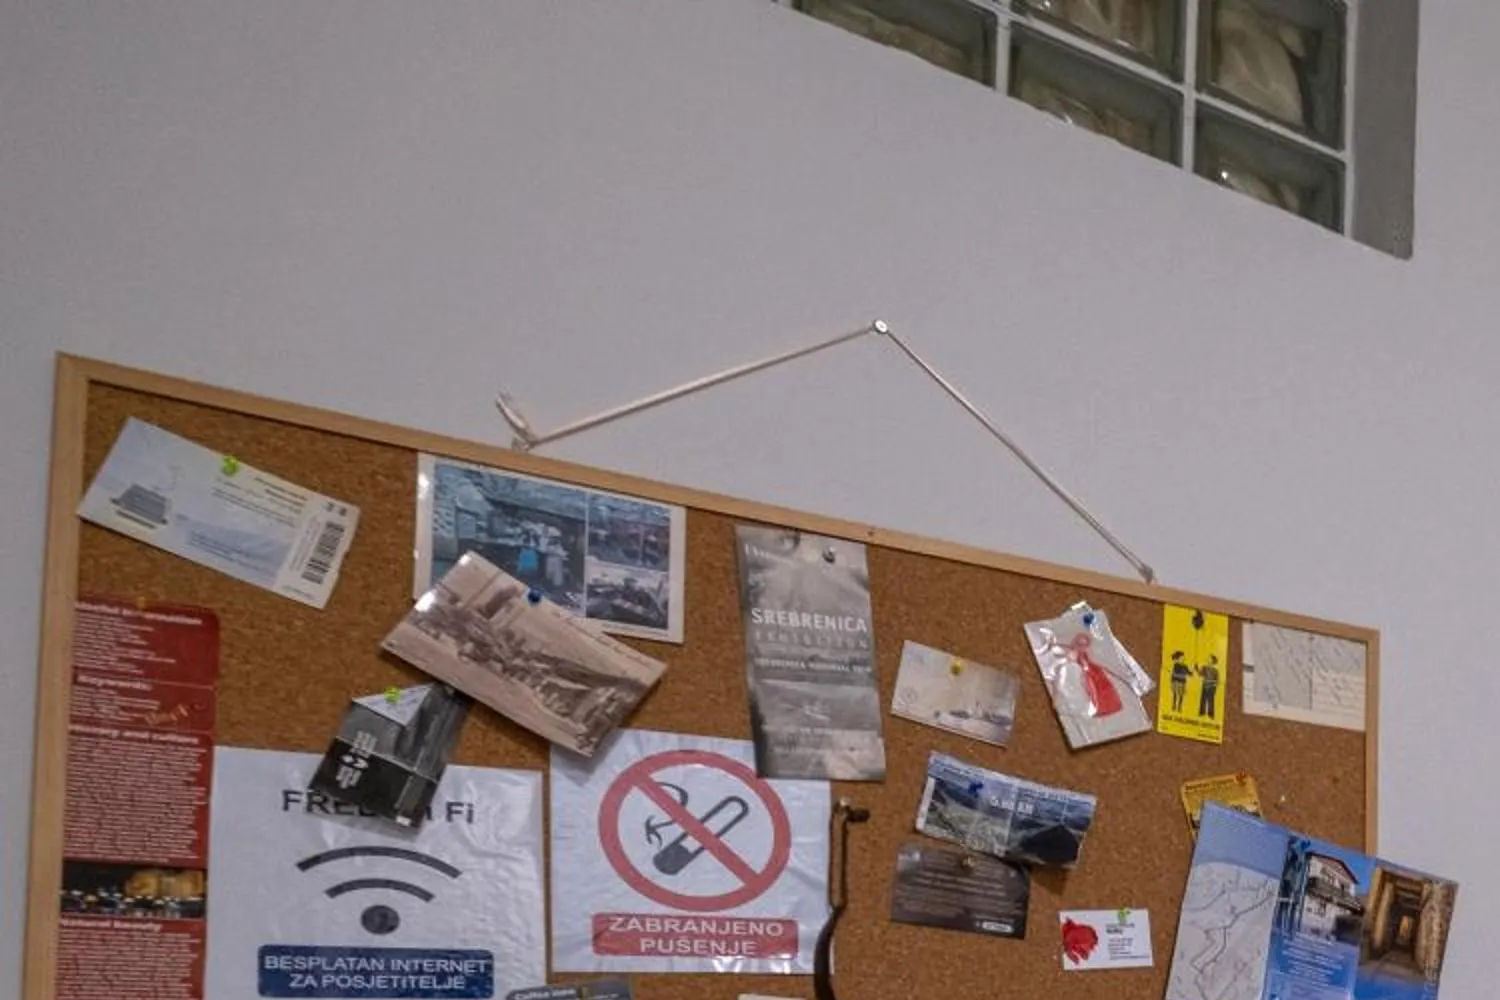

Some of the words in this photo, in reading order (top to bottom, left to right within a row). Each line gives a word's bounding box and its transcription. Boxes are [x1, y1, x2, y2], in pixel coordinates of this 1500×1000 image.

[751, 607, 867, 633] SREBRENICA
[445, 801, 475, 824] Fi
[608, 916, 784, 937] ZABRANJENO
[640, 935, 757, 956] PUŠENJE
[264, 955, 385, 972] BESPLATAN
[390, 958, 488, 974] INTERNET
[288, 973, 318, 989] ZA
[322, 974, 465, 990] POSJETITELJE
